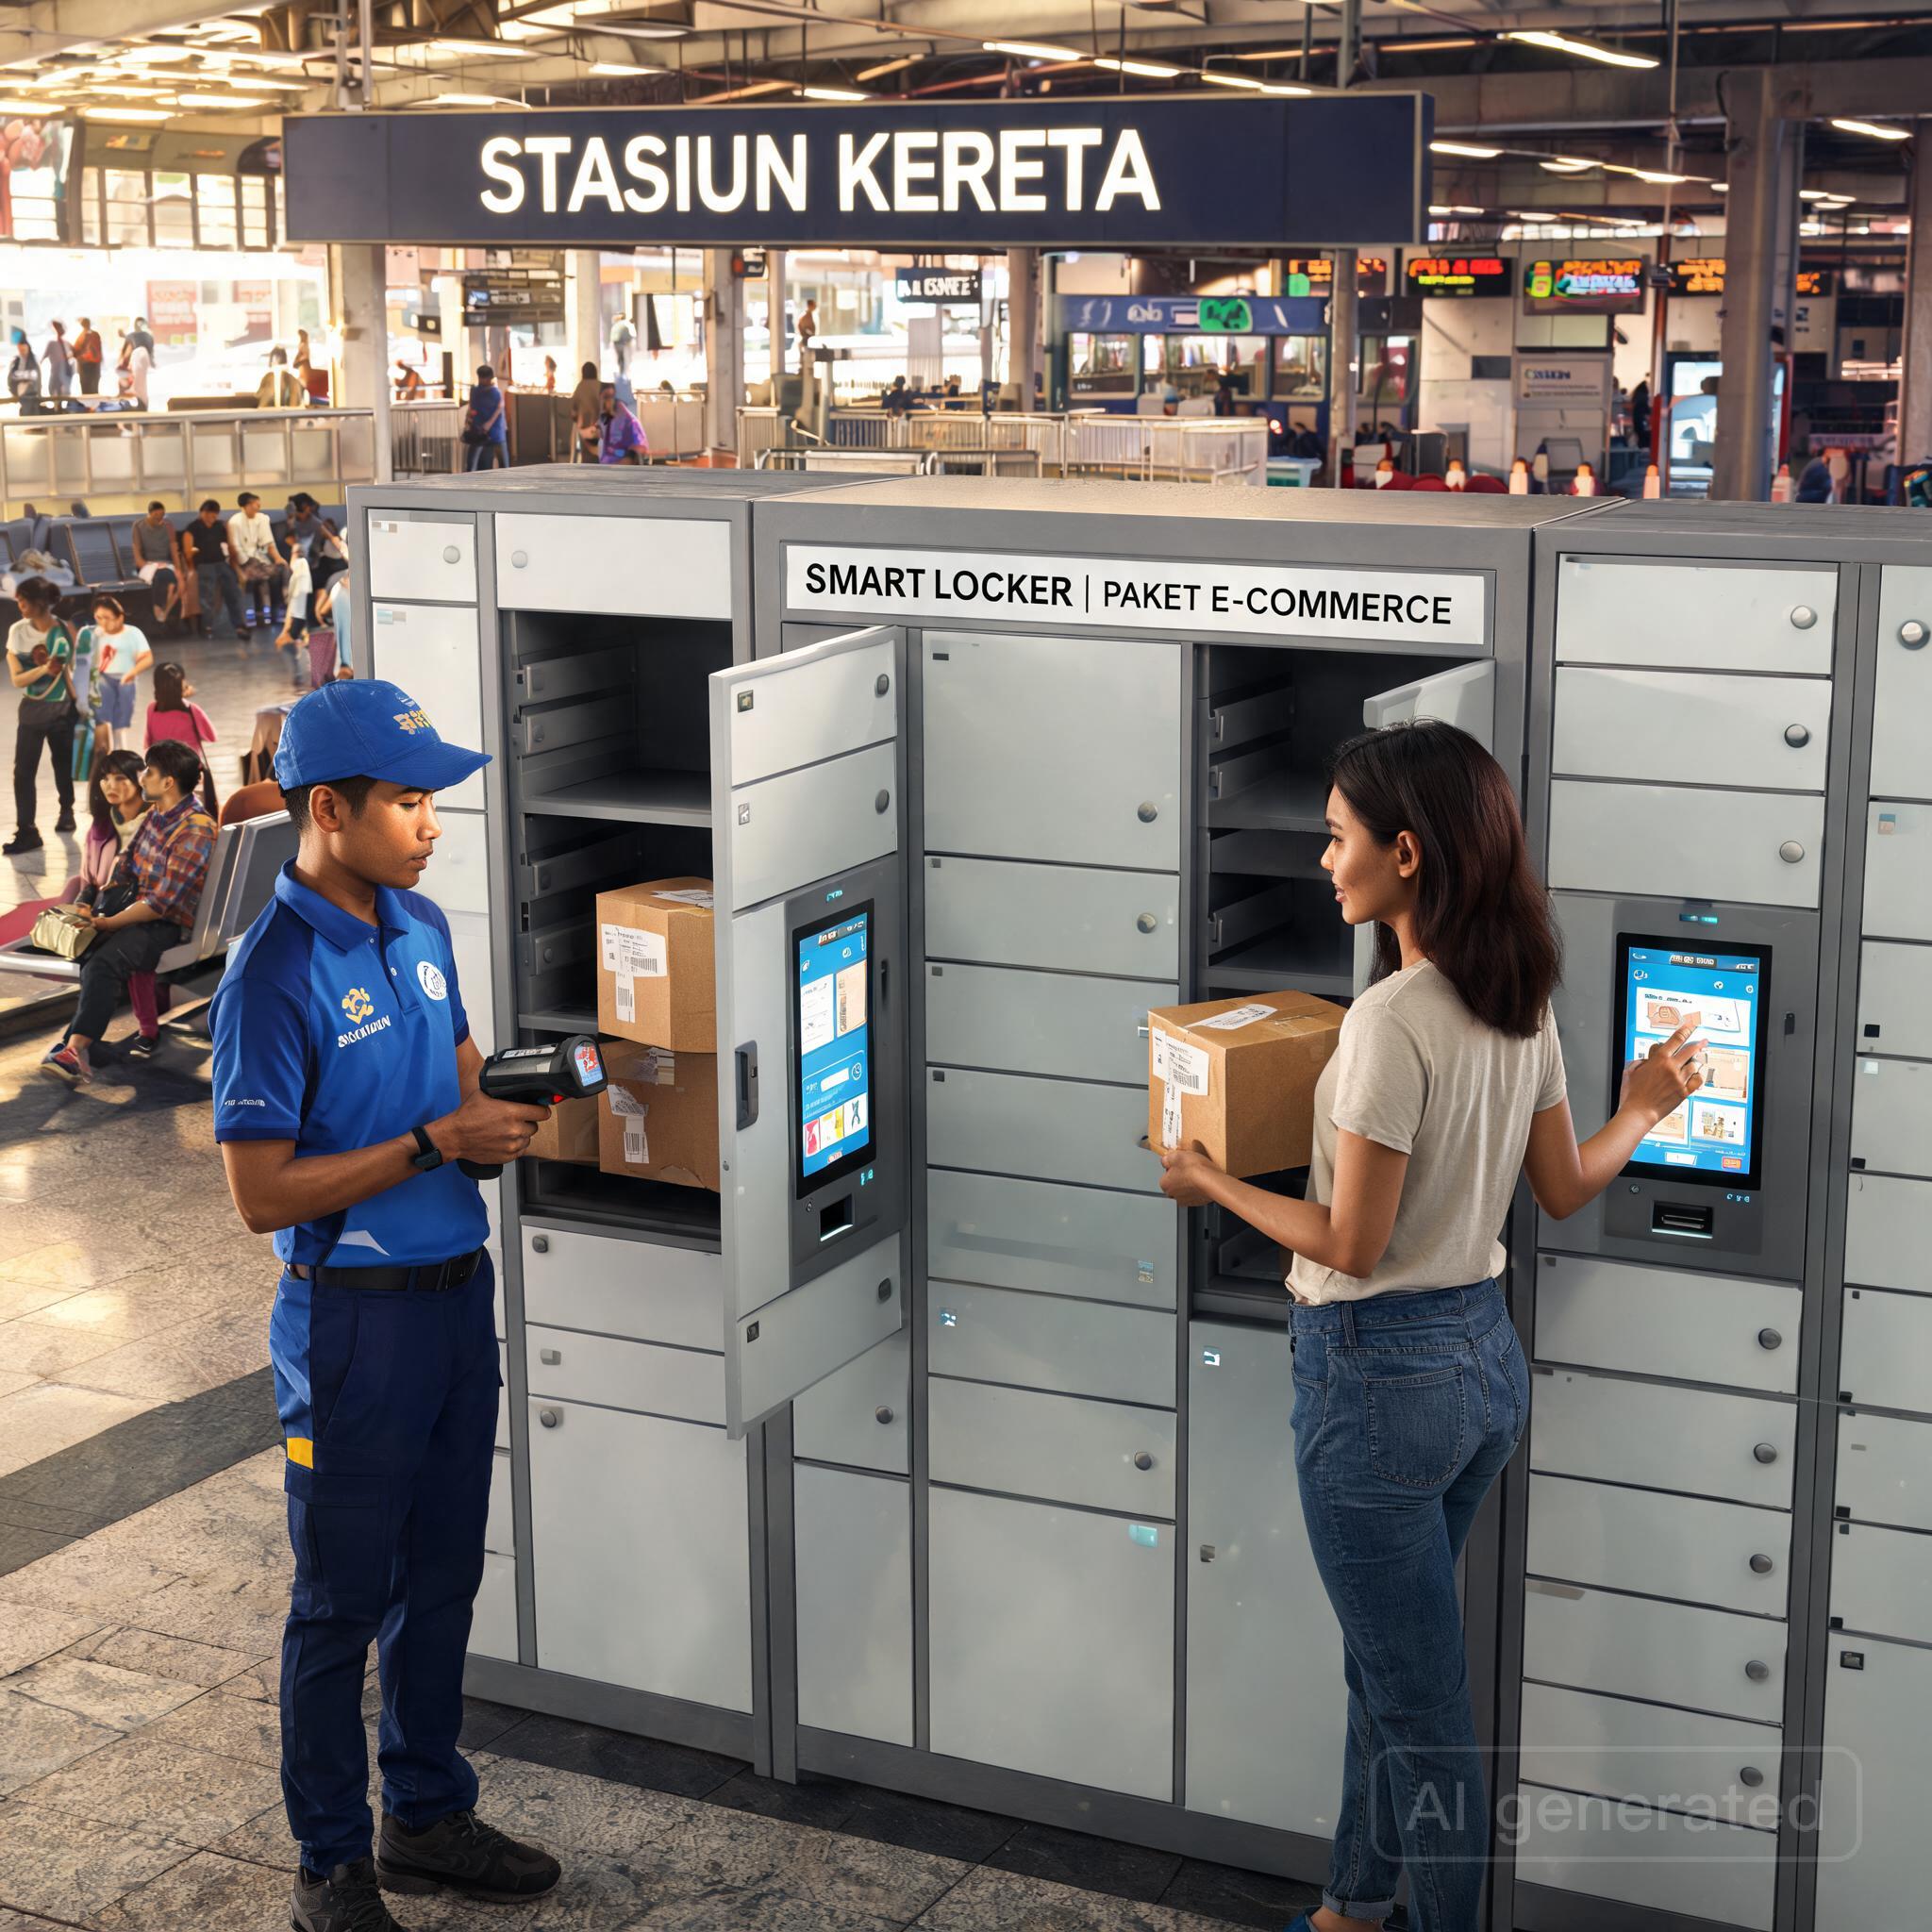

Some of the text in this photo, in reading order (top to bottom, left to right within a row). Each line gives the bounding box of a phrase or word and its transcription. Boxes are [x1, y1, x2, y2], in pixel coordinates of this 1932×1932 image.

[479, 127, 1162, 214] STASIUN KERETA
[806, 562, 1453, 625] SMART LOCKER PAKET E-COMMERCE
